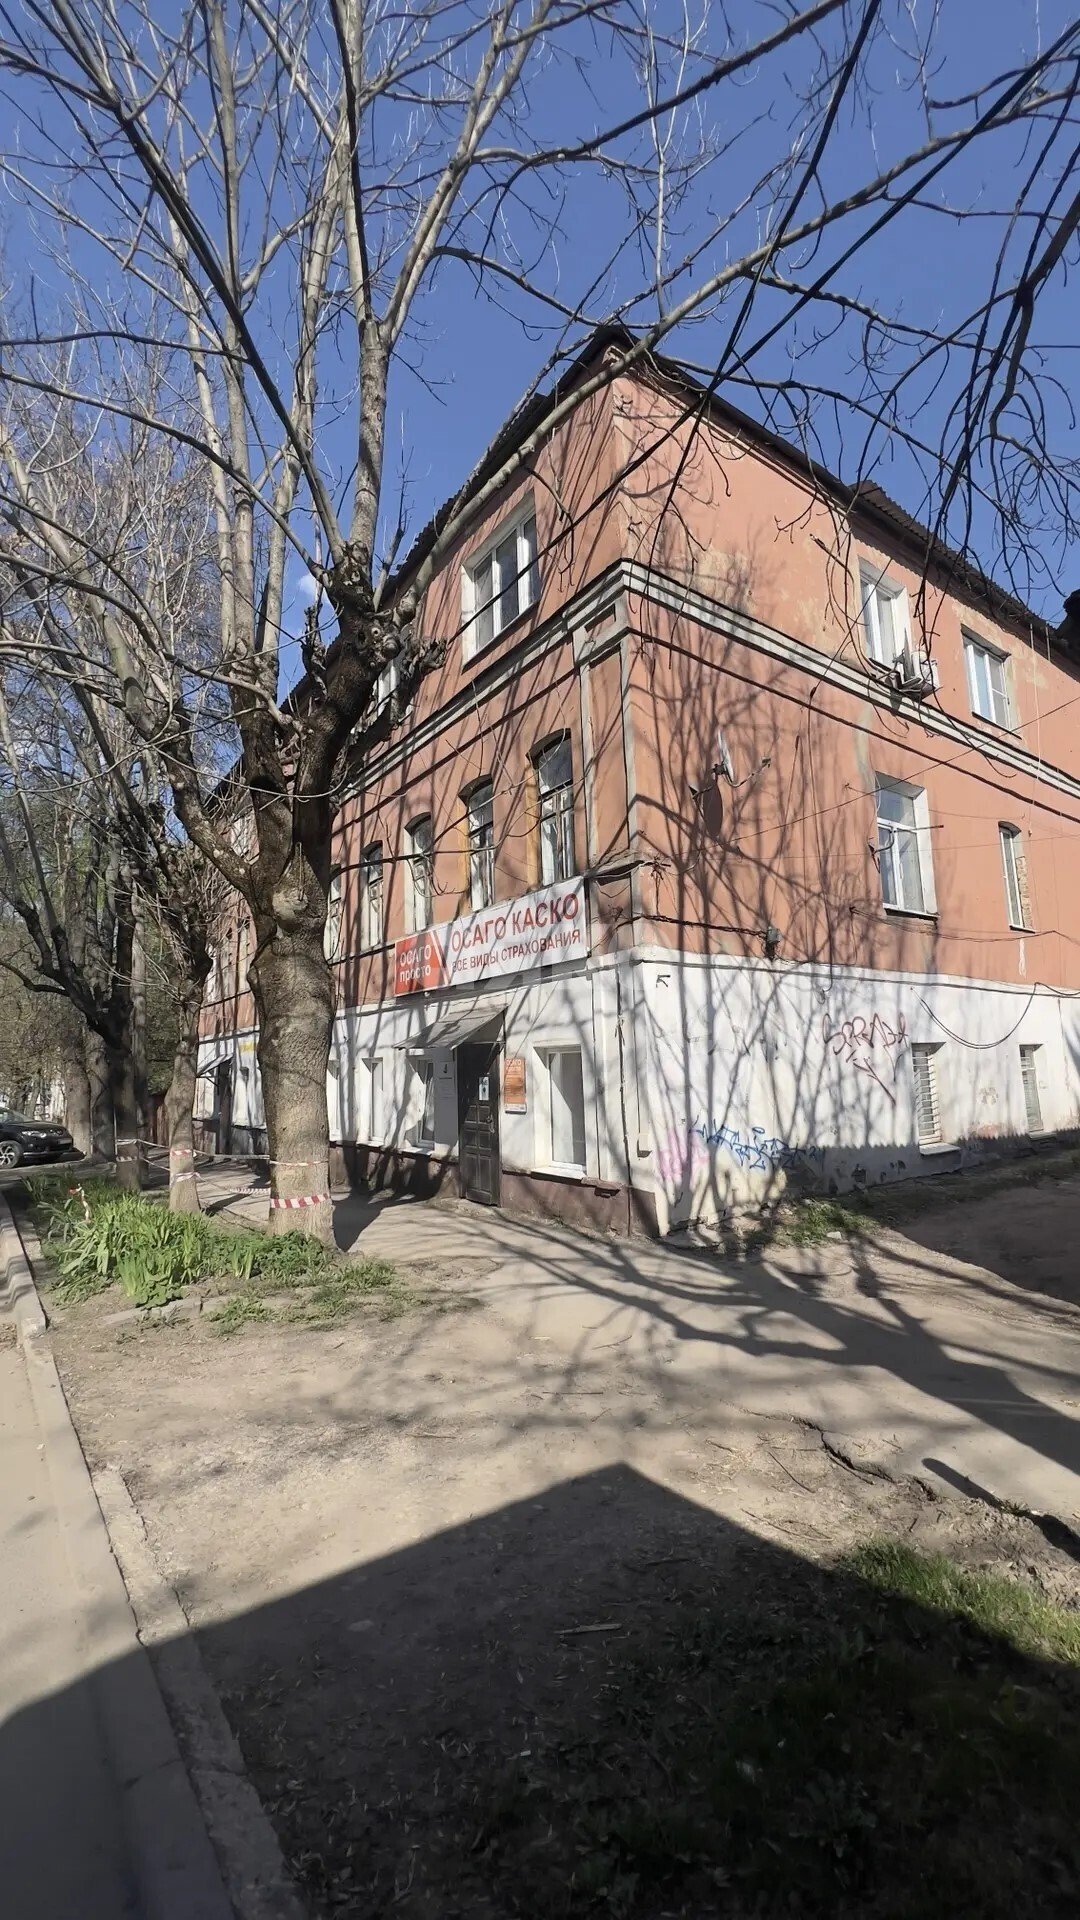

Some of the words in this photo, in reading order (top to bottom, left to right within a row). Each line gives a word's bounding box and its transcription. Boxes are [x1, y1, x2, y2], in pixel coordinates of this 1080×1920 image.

[451, 916, 506, 953] ОСАГО
[512, 893, 579, 937] КАСКО
[400, 944, 432, 967] ОСАГО
[452, 959, 468, 972] ВСЕ
[470, 953, 499, 970] ВИДЫ
[501, 929, 581, 962] СТРАХОВАНИЯ
[400, 964, 431, 984] просто
